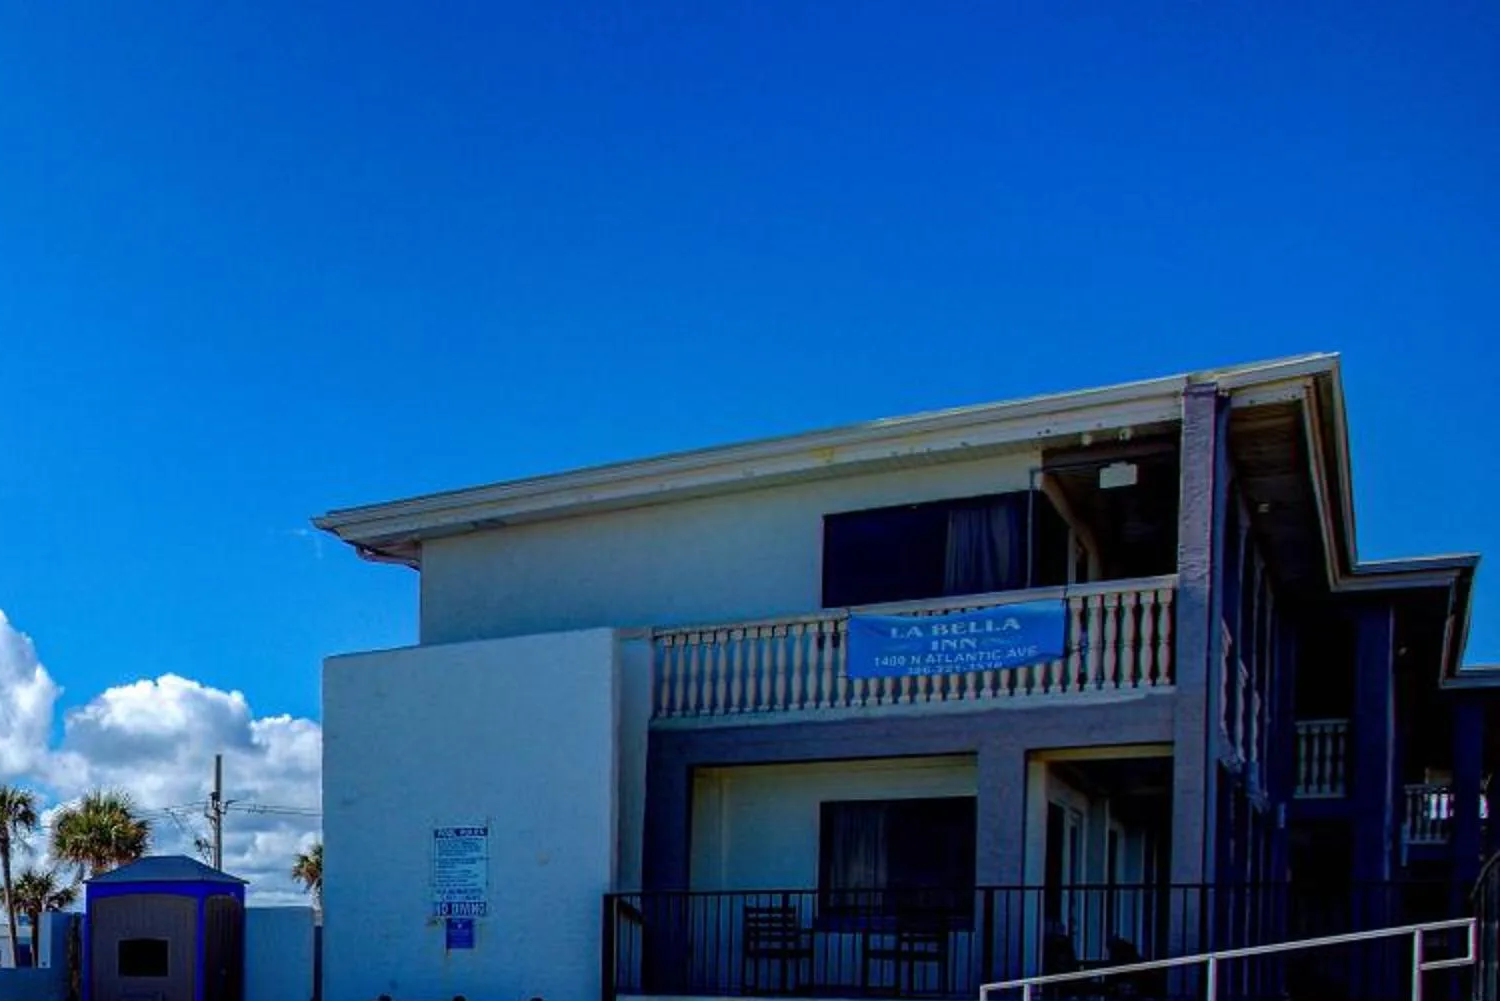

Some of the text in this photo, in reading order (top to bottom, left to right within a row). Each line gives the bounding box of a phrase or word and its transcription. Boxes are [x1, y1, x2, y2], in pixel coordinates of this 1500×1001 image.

[890, 617, 1021, 639] LA BELLA
[931, 637, 978, 651] INN
[910, 655, 921, 665] N
[925, 650, 1001, 666] ATLANTIC
[1006, 645, 1039, 659] AVE
